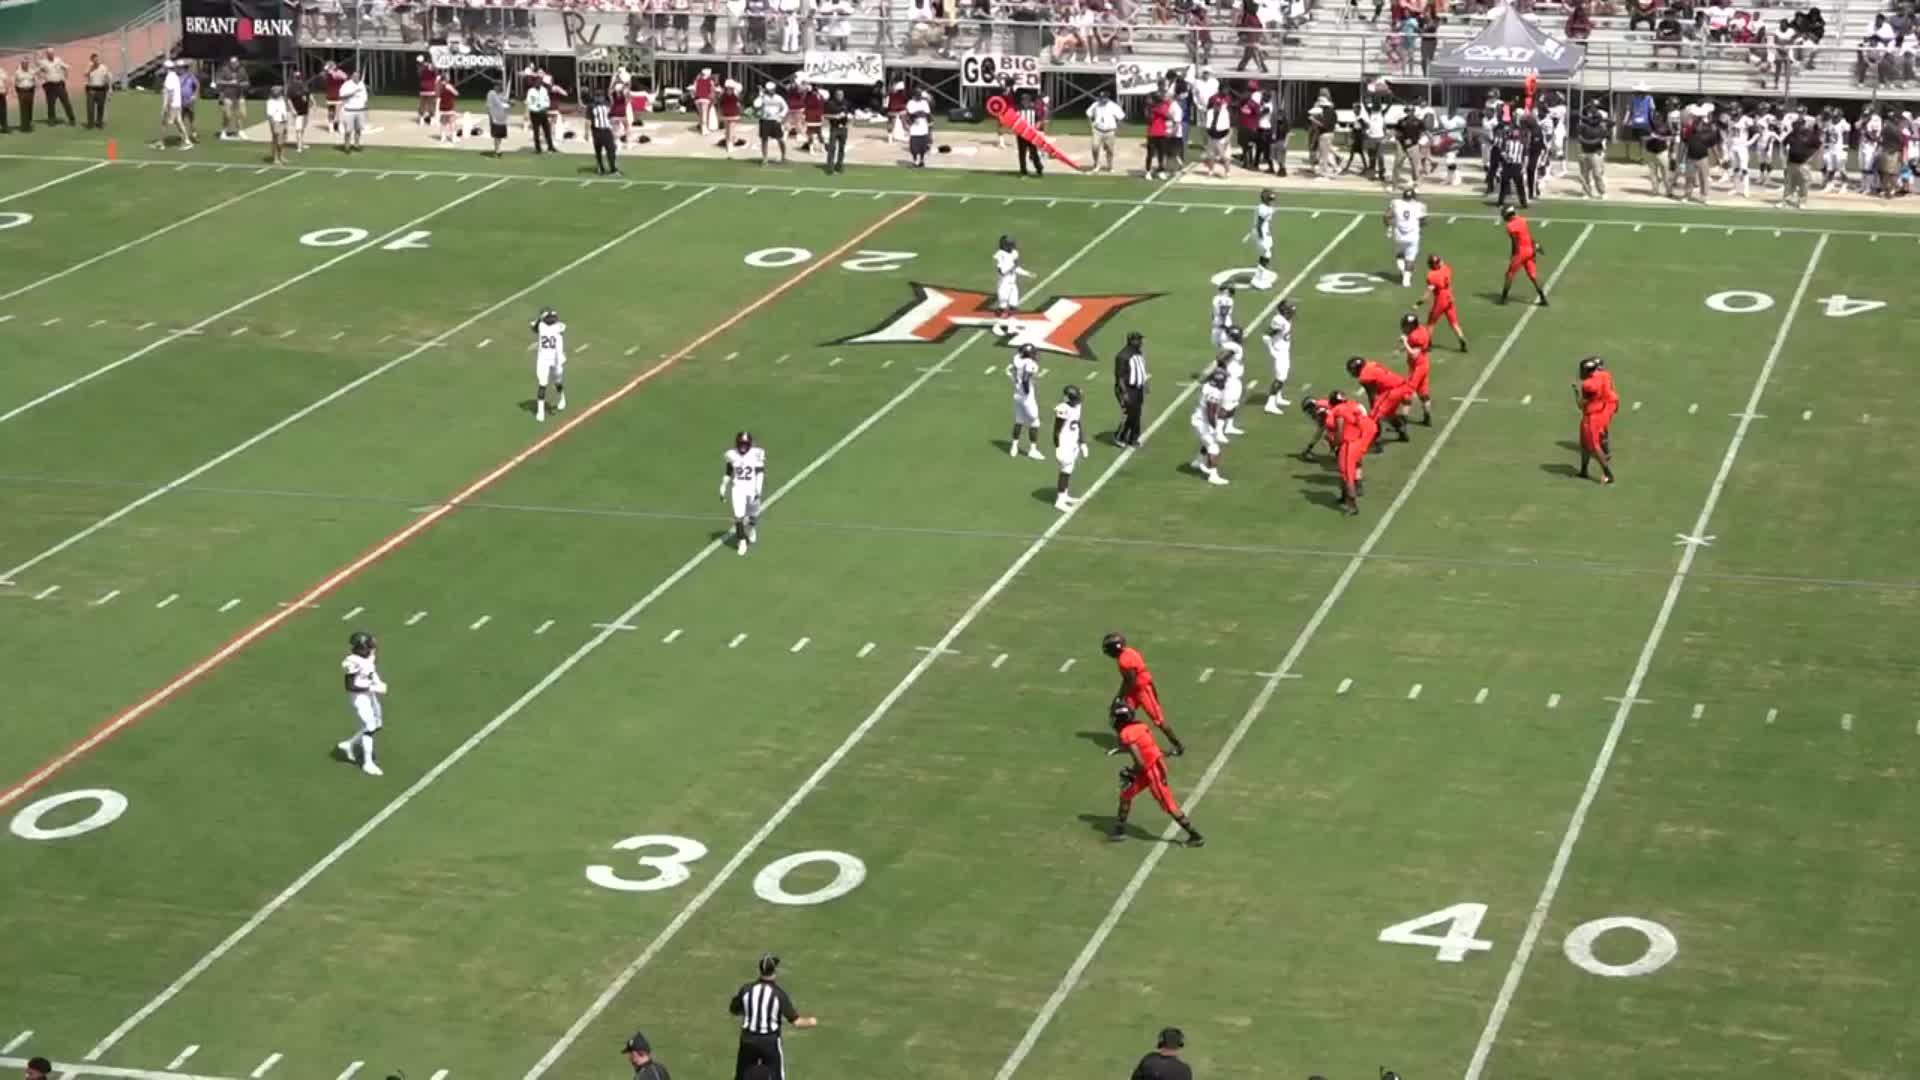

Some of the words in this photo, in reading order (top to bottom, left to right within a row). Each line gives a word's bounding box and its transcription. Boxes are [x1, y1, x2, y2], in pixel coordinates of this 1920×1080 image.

[185, 16, 236, 34] BRYANT
[253, 18, 293, 36] BANK
[964, 57, 996, 84] GO
[1000, 57, 1036, 70] BIG
[541, 335, 557, 349] 20
[735, 465, 753, 481] 22
